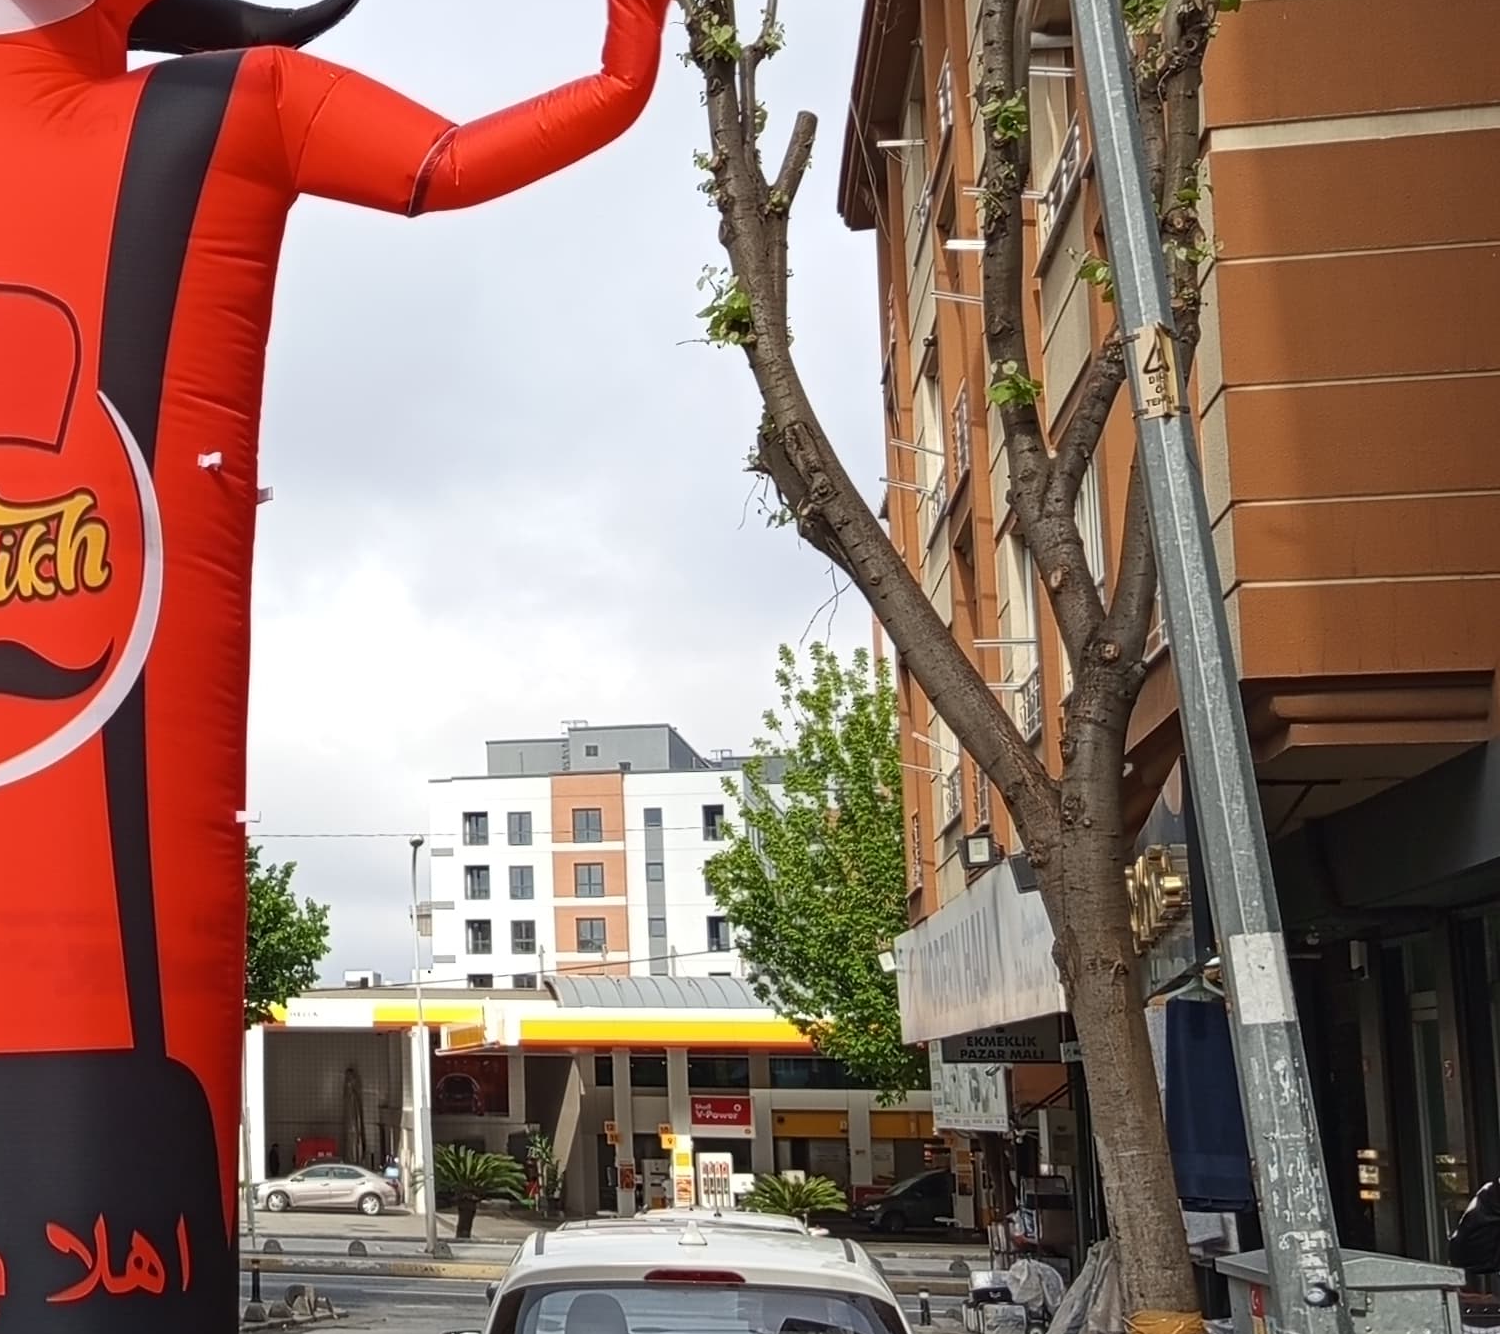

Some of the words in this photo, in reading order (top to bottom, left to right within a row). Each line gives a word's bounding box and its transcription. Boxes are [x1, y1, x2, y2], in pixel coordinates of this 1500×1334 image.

[966, 1035, 1037, 1047] EKMEKLİK
[960, 1049, 1005, 1060] PAZAR
[1010, 1049, 1045, 1060] MALI
